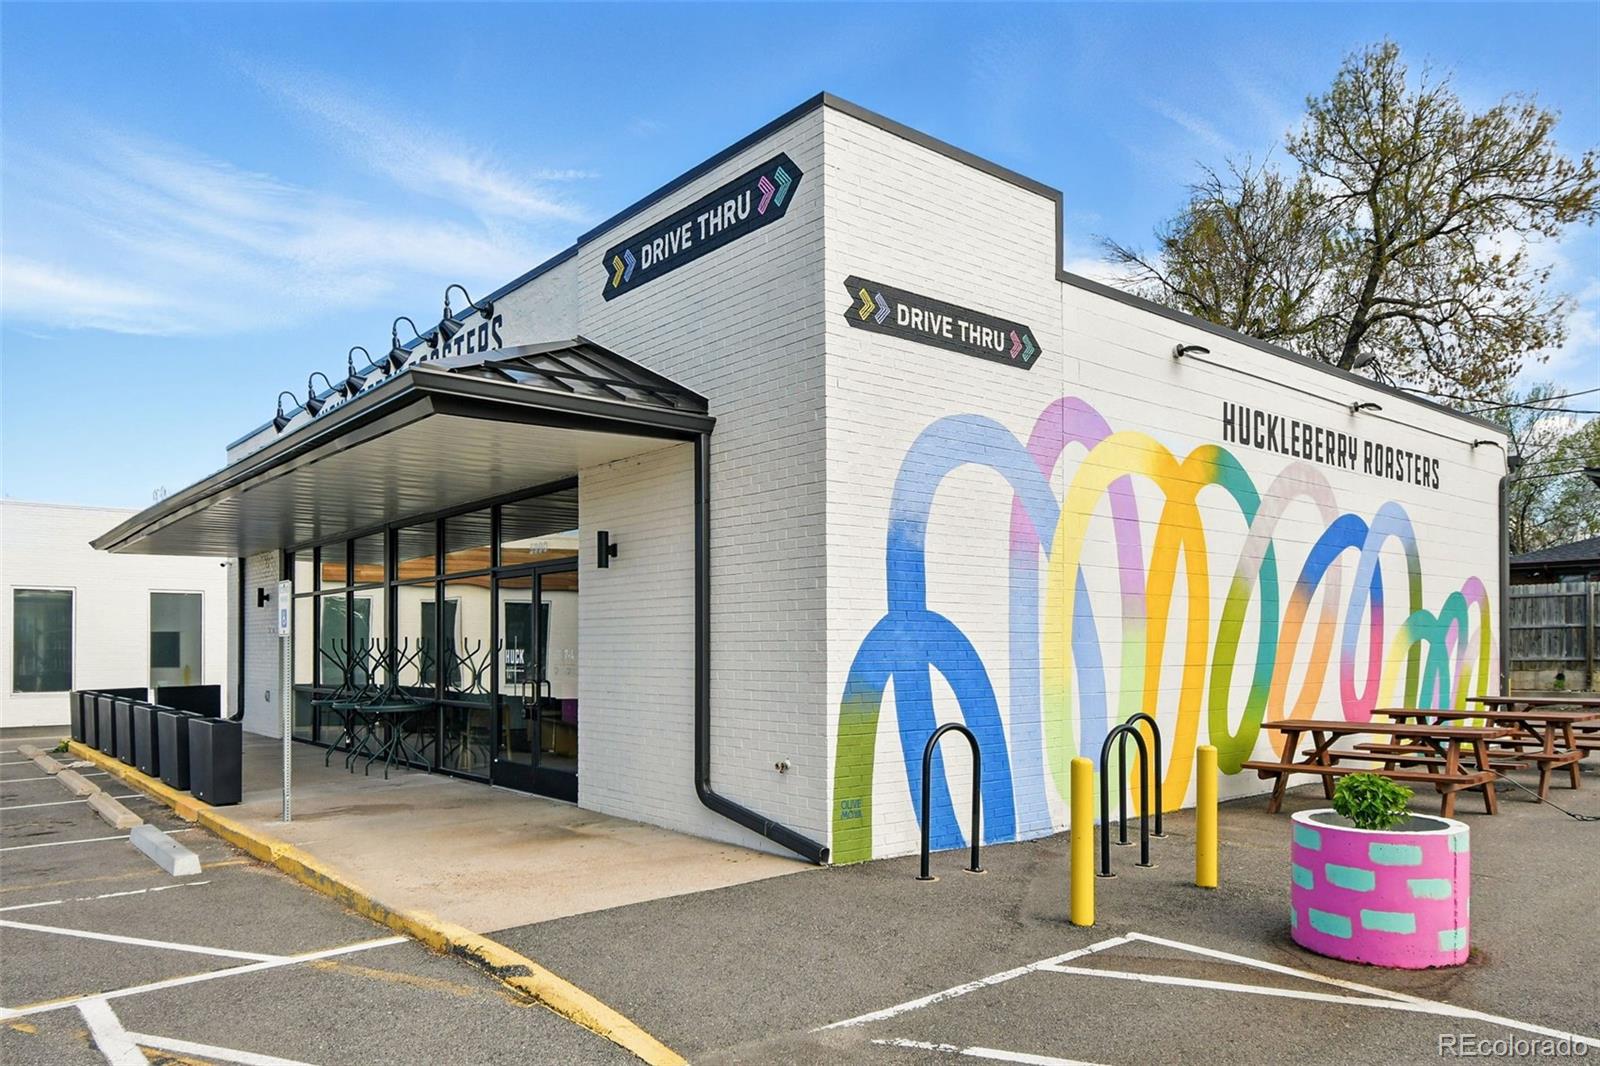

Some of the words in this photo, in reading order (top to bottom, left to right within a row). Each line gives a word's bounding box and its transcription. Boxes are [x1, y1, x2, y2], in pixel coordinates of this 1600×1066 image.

[640, 221, 693, 270] DRIVE
[698, 190, 751, 240] THRU
[896, 303, 953, 338] DRIVE
[957, 320, 1005, 352] THRU
[1223, 402, 1358, 470] HUCKLEBERRY
[1364, 441, 1440, 489] ROASTERS
